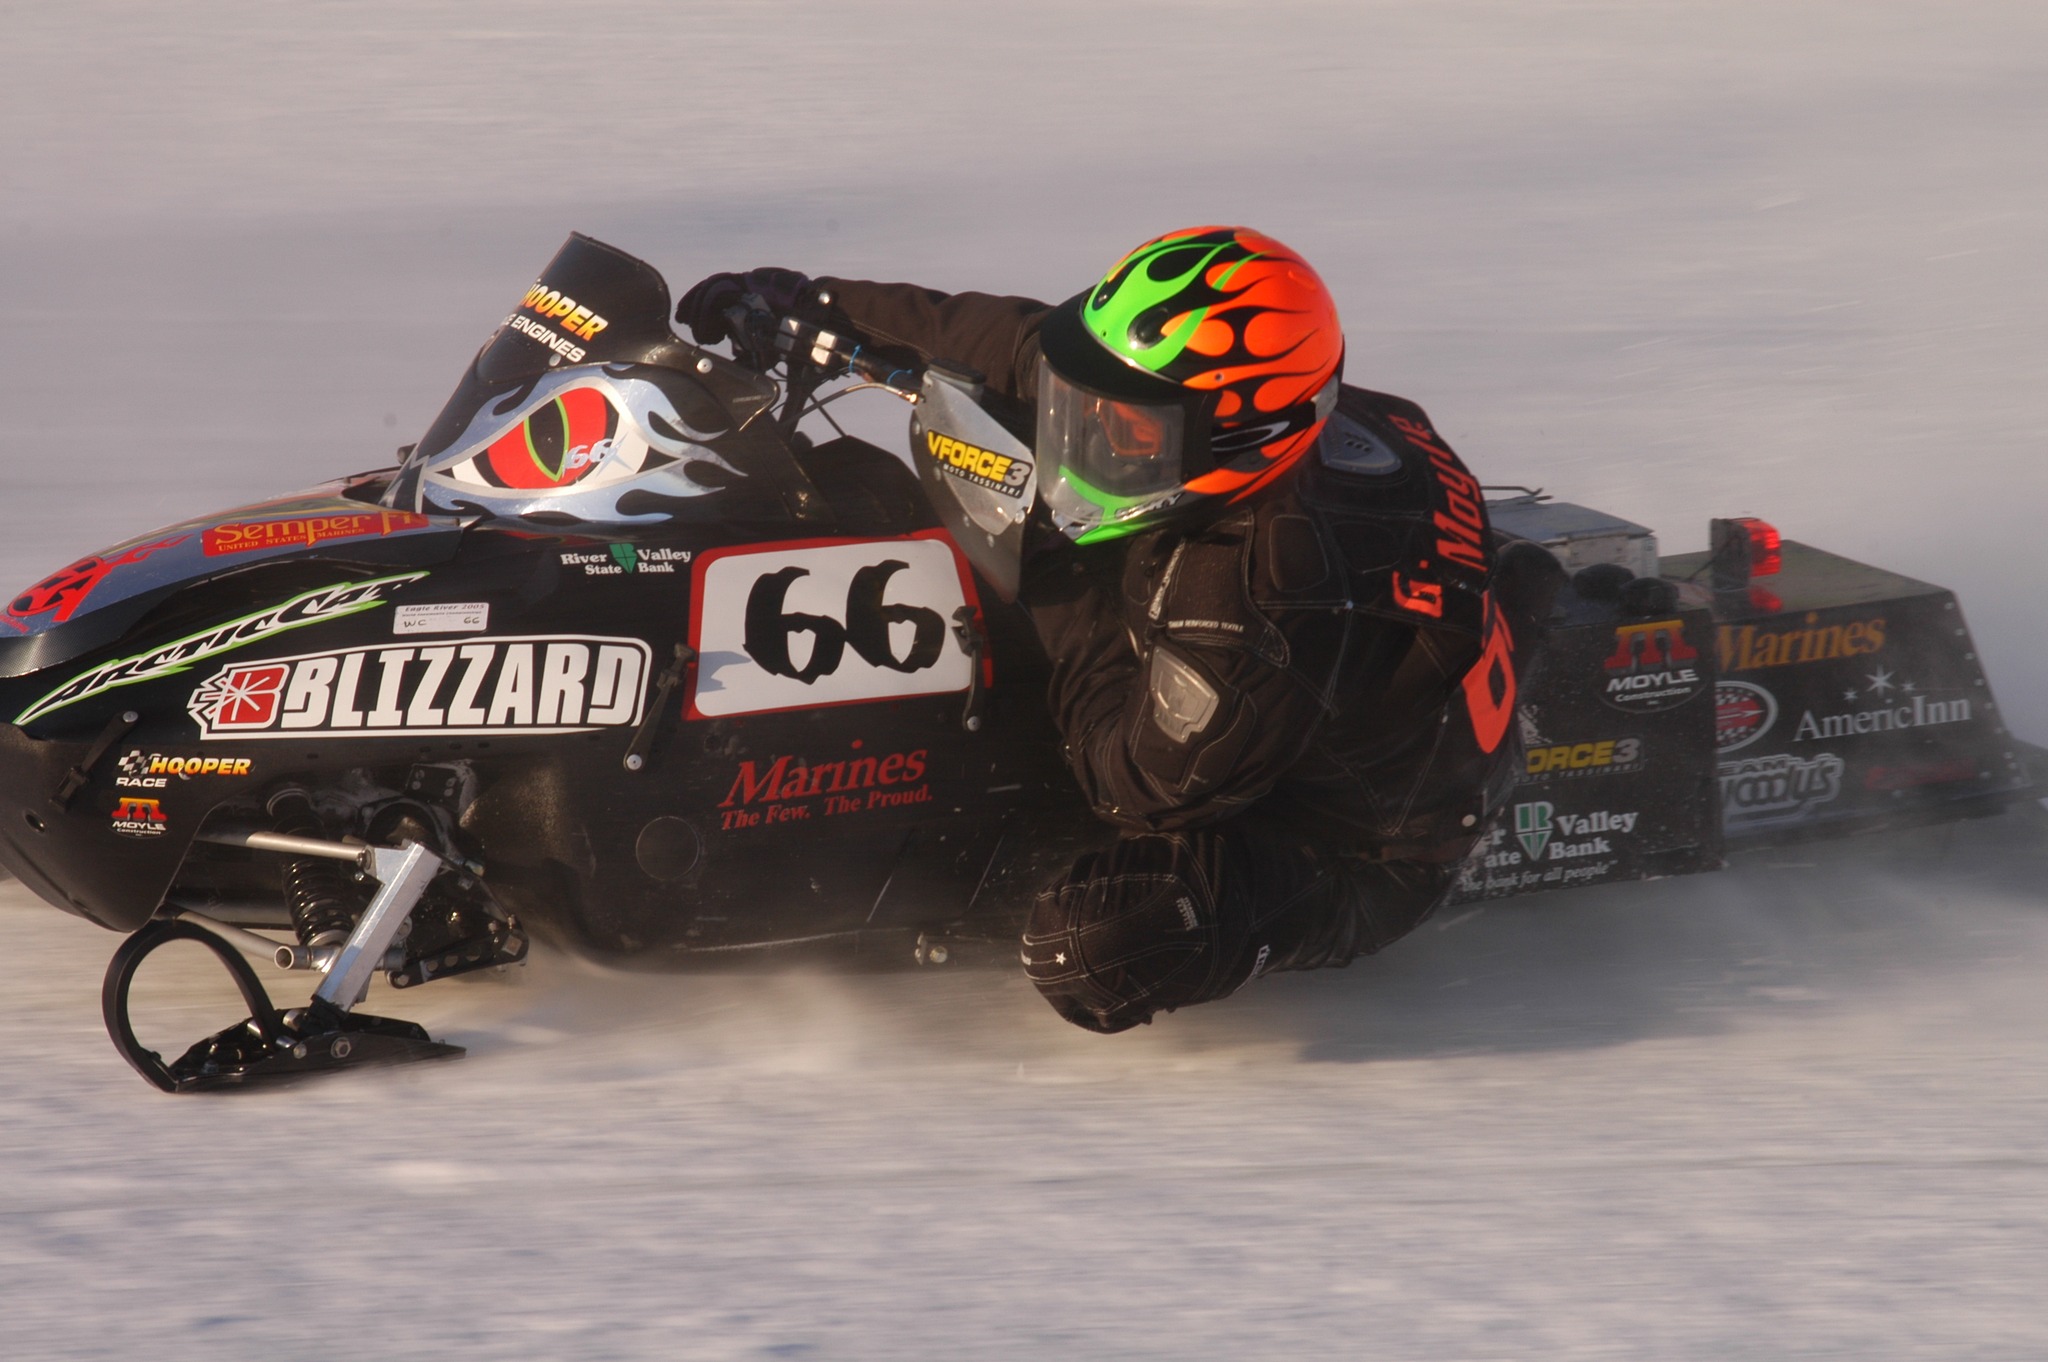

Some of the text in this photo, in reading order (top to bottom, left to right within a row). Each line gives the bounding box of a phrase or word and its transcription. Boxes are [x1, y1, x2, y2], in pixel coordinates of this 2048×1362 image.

[510, 315, 586, 363] ENGINES
[943, 463, 1021, 497] MOTO TASSINARI
[214, 515, 372, 548] Semper
[218, 540, 259, 552] UNITED
[265, 534, 307, 546] STATES
[560, 548, 692, 565] River Valley
[584, 562, 675, 575] State Bank
[404, 605, 431, 613] Eagle
[742, 559, 946, 685] 66
[281, 643, 643, 728] BLIZZARD
[1606, 669, 1699, 692] MOYLE
[1792, 695, 1972, 742] AmericInn
[149, 756, 252, 775] HOOPER
[717, 739, 928, 808] Marines
[115, 777, 168, 788] RACE
[720, 784, 933, 831] The Few. The Proud.
[112, 821, 167, 831] MOYLE
[1556, 811, 1639, 836] Valley
[1484, 836, 1612, 868] ate Bank
[1520, 870, 1541, 888] for
[1543, 867, 1563, 882] all
